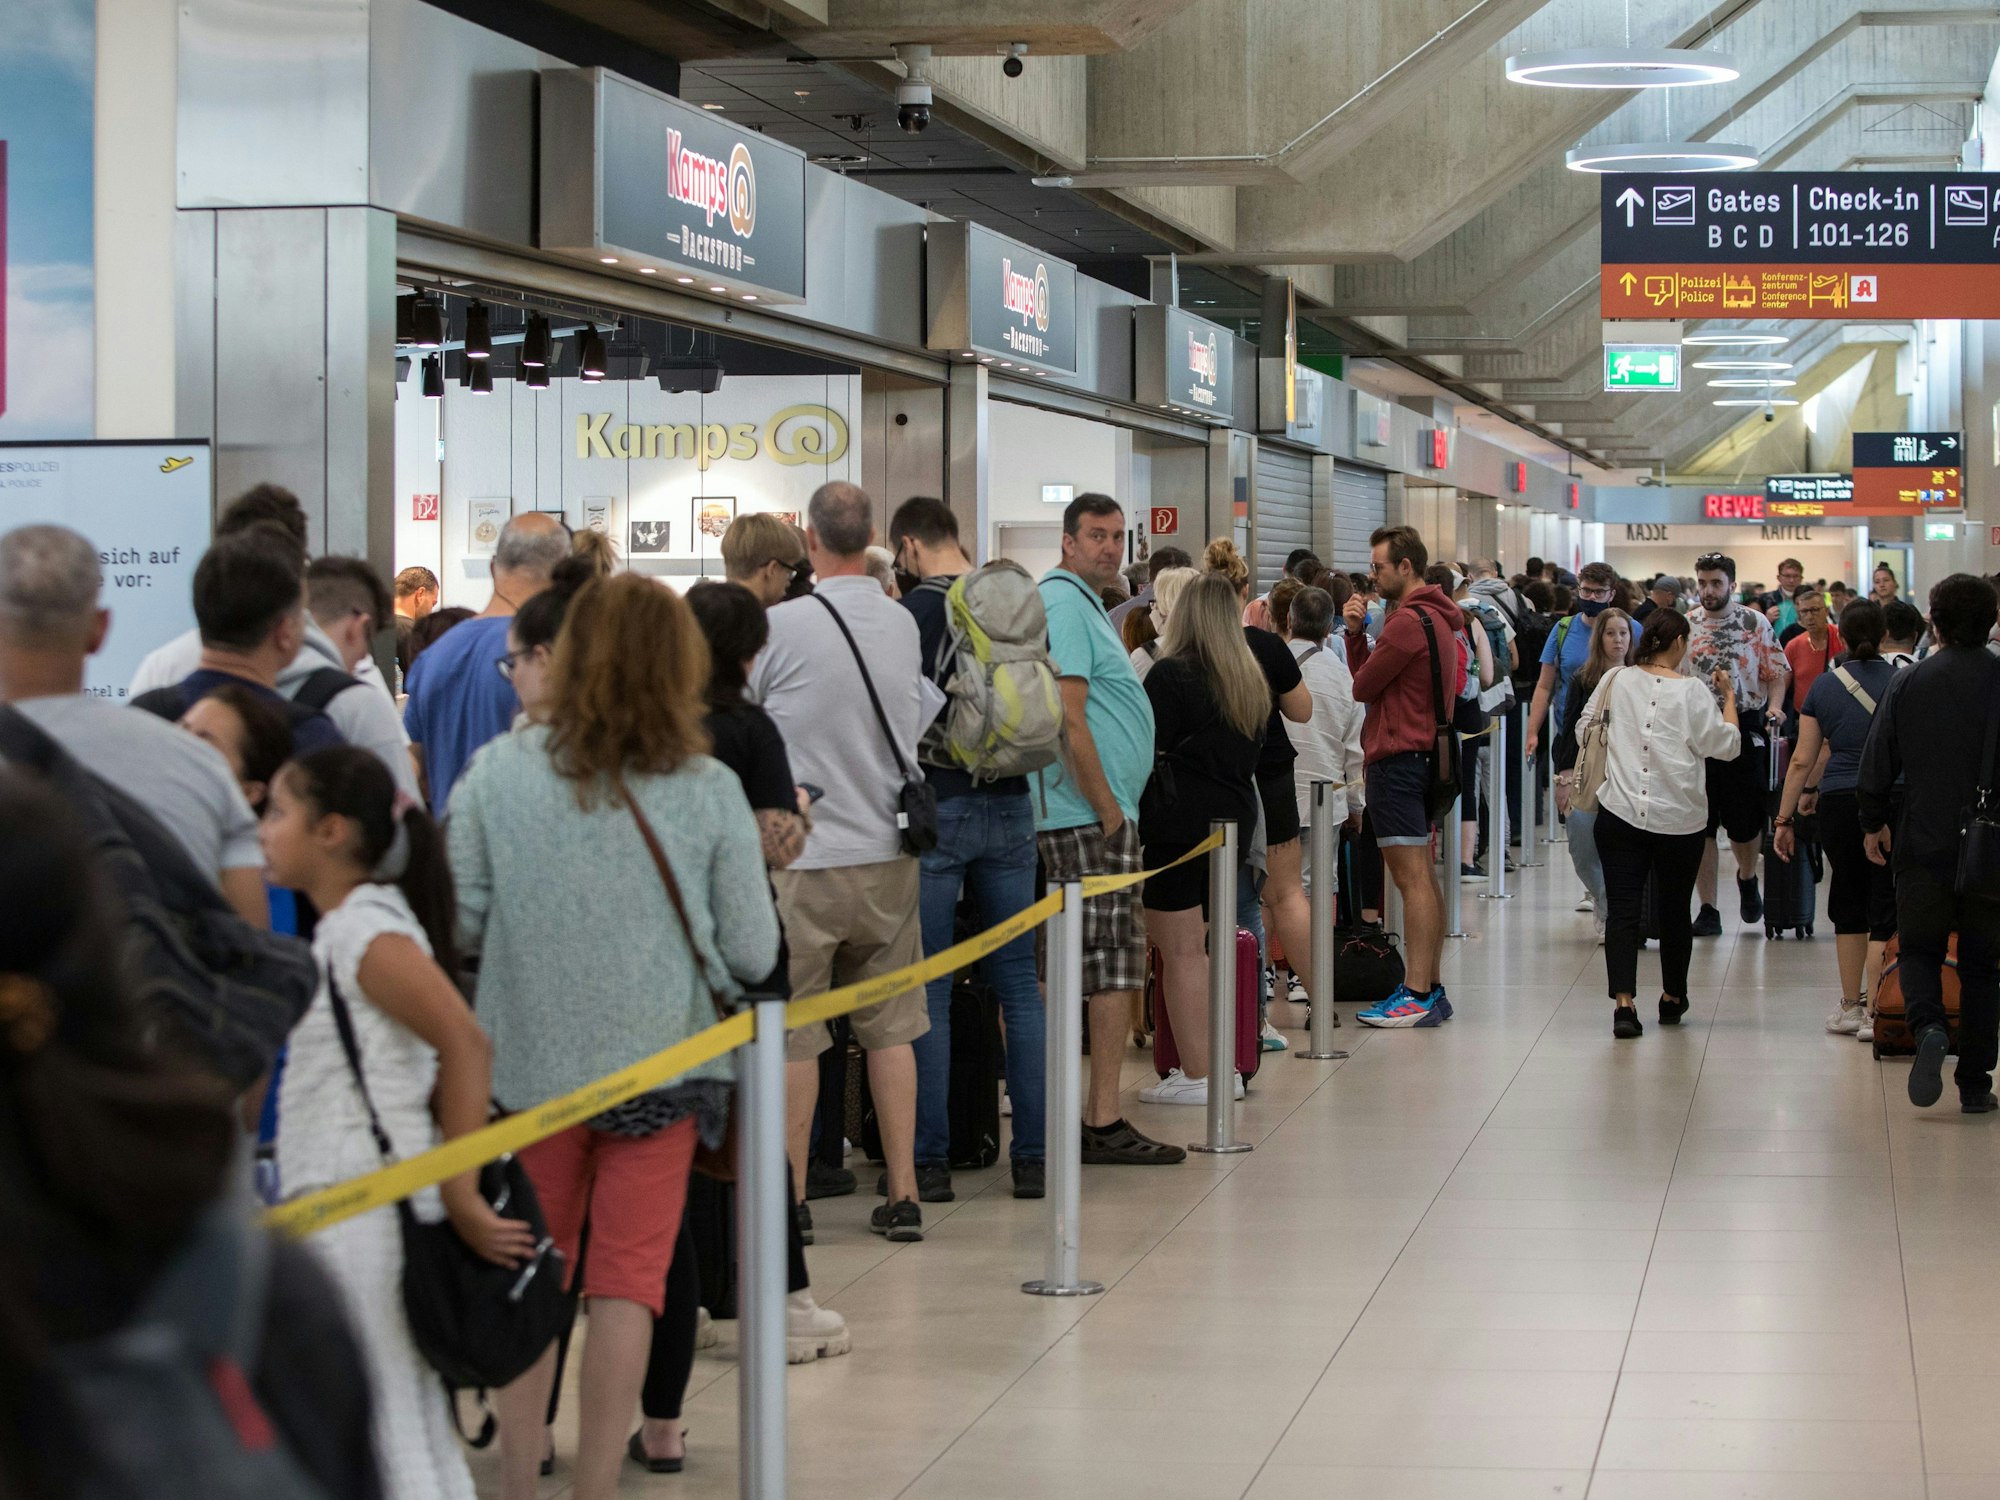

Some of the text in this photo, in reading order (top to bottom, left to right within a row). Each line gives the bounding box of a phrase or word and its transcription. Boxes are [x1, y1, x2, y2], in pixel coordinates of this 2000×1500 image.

[666, 127, 728, 228] Kamps
[1708, 189, 1781, 213] Gates
[1809, 187, 1919, 211] Check-in
[1708, 225, 1774, 249] B C D
[1809, 223, 1910, 247] 101-126
[681, 224, 743, 272] BACKSTUBE
[1680, 277, 1722, 288] Polizei
[1761, 272, 1809, 283] Konferenz-
[1761, 281, 1798, 290] zentrum
[1002, 257, 1035, 327] Kamps
[1680, 291, 1715, 303] Police
[1761, 292, 1808, 301] Conference
[1761, 300, 1790, 309] center
[576, 412, 758, 472] Kamps
[1705, 494, 1765, 519] REWE
[99, 547, 181, 565] sich auf
[114, 574, 152, 588] vor:
